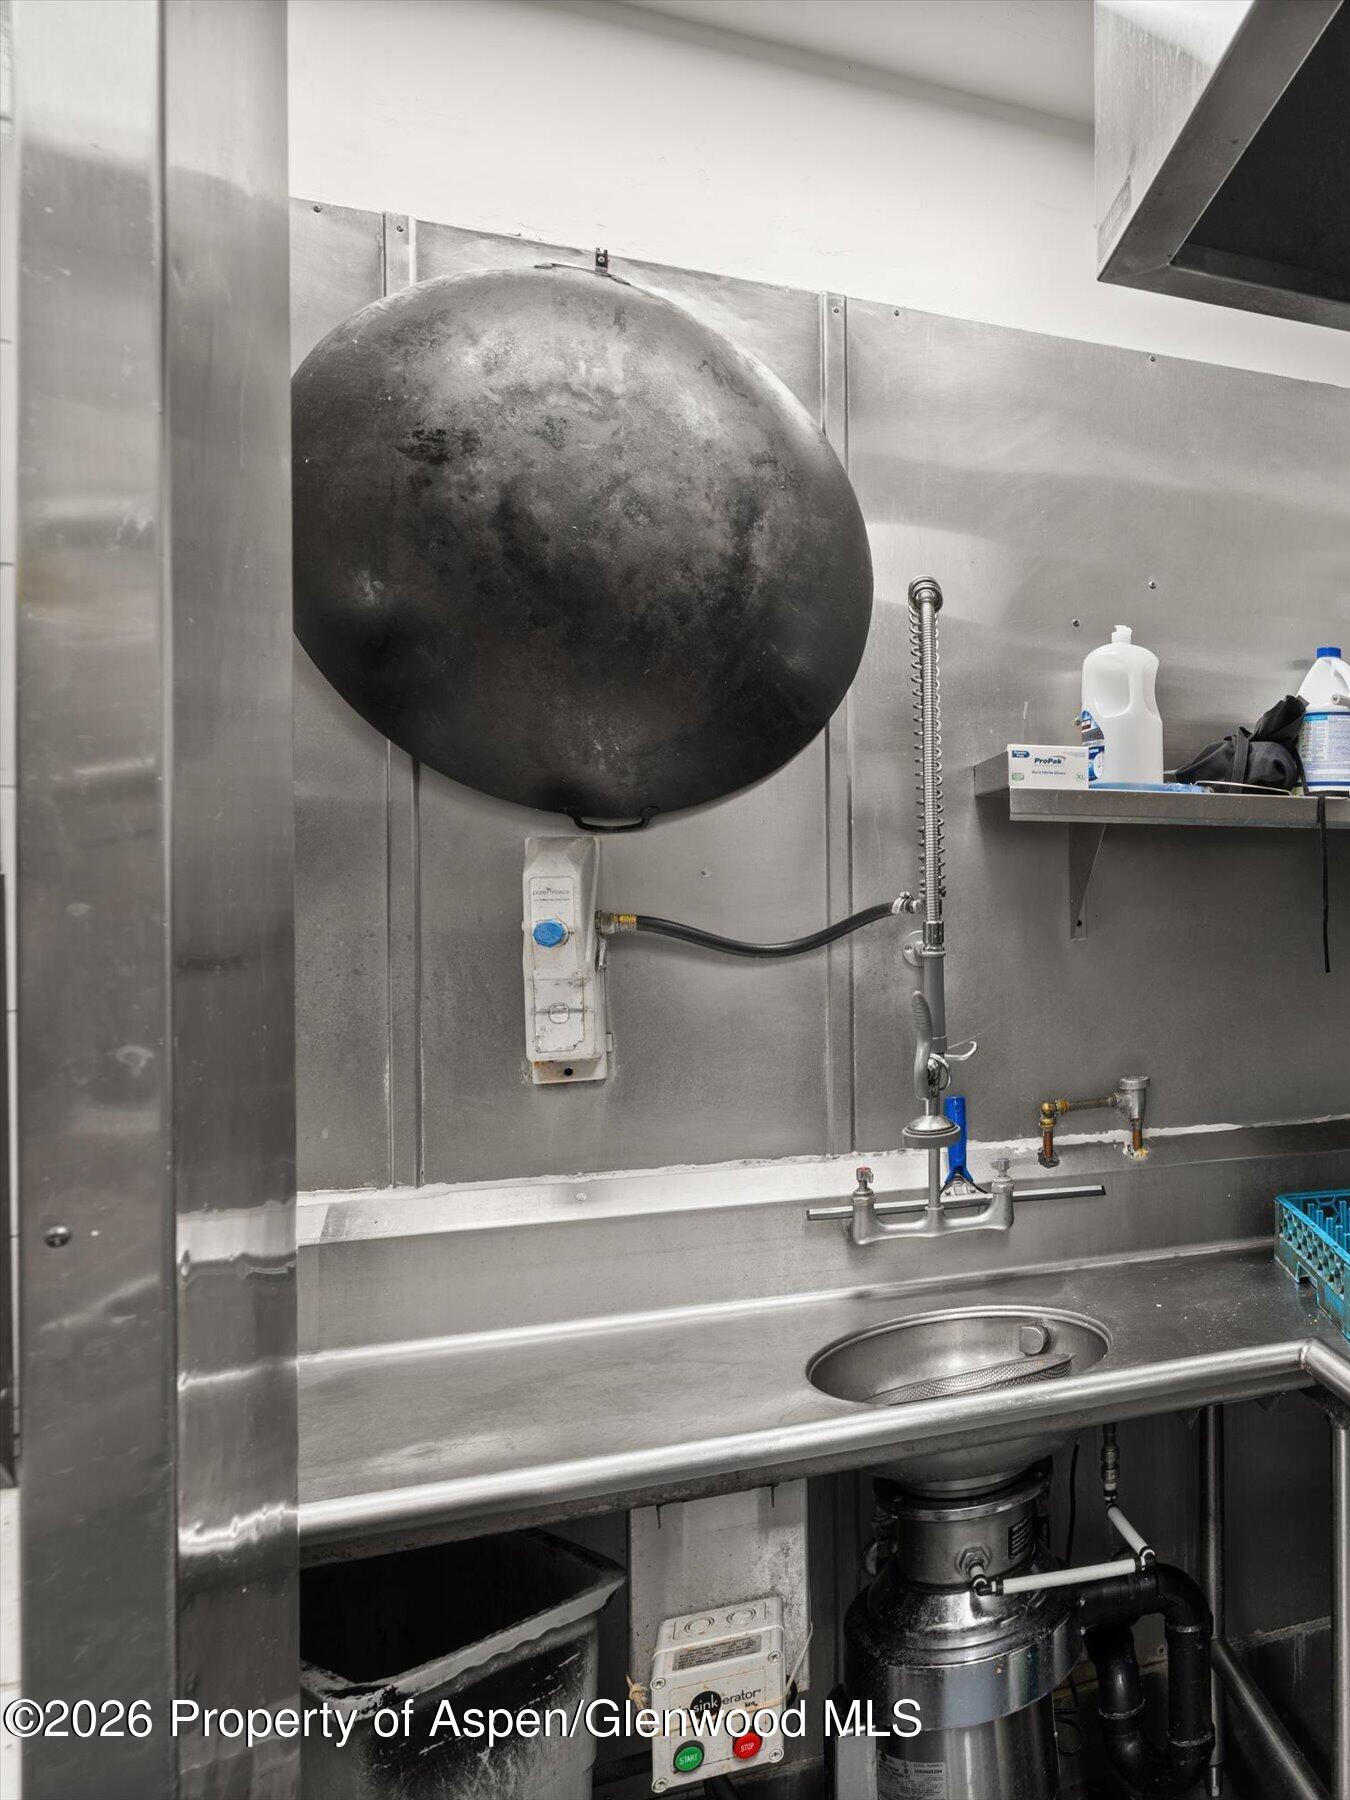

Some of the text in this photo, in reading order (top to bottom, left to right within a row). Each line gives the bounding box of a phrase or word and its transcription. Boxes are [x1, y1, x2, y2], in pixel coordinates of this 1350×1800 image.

[1034, 757, 1062, 766] ProPak
[740, 1742, 754, 1752] STOP
[680, 1752, 698, 1765] START
